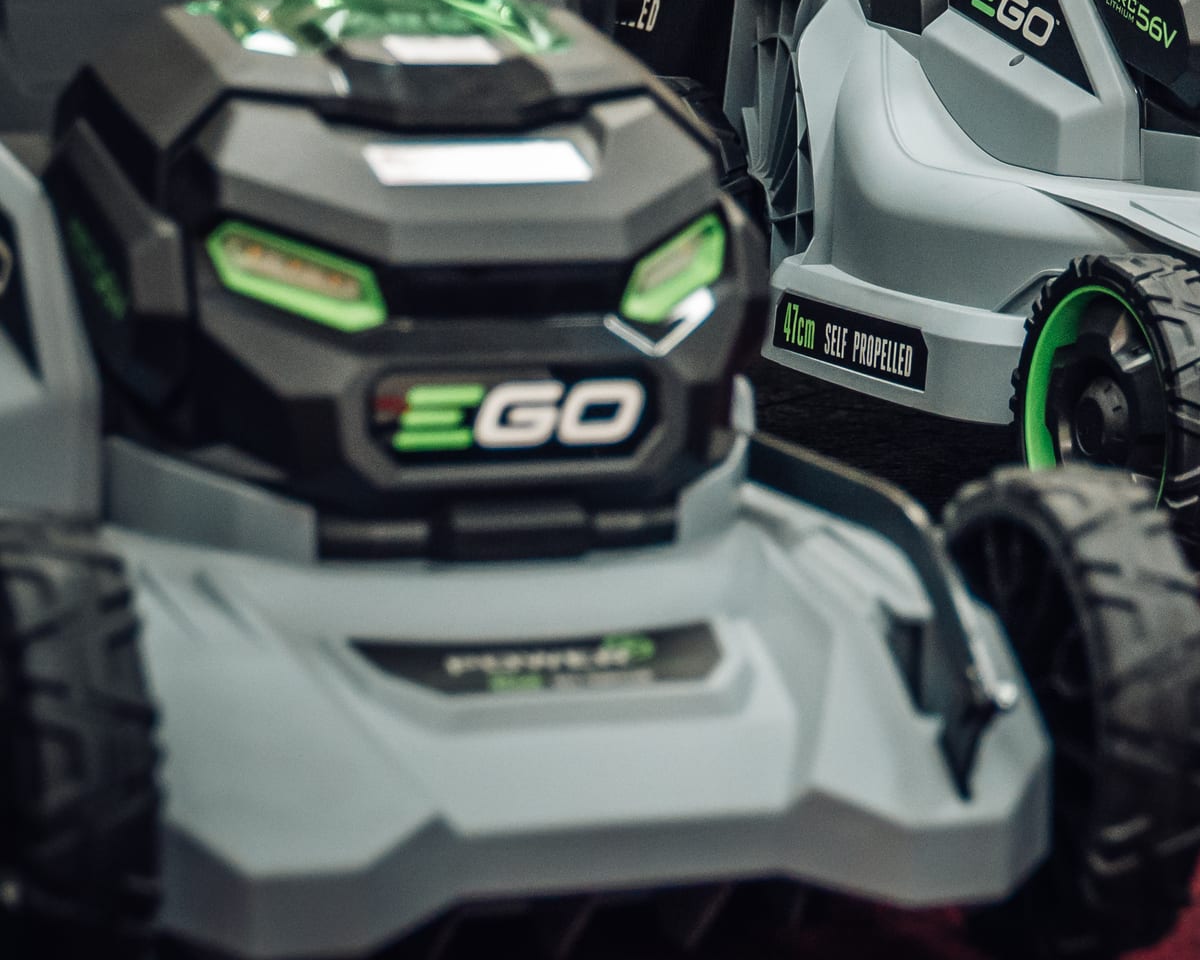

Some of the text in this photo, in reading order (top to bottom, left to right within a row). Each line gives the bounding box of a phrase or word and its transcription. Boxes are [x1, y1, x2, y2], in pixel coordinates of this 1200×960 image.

[1135, 4, 1178, 49] 56V
[783, 302, 913, 378] 47cm SELF PROPELLED
[392, 379, 646, 453] EGO
